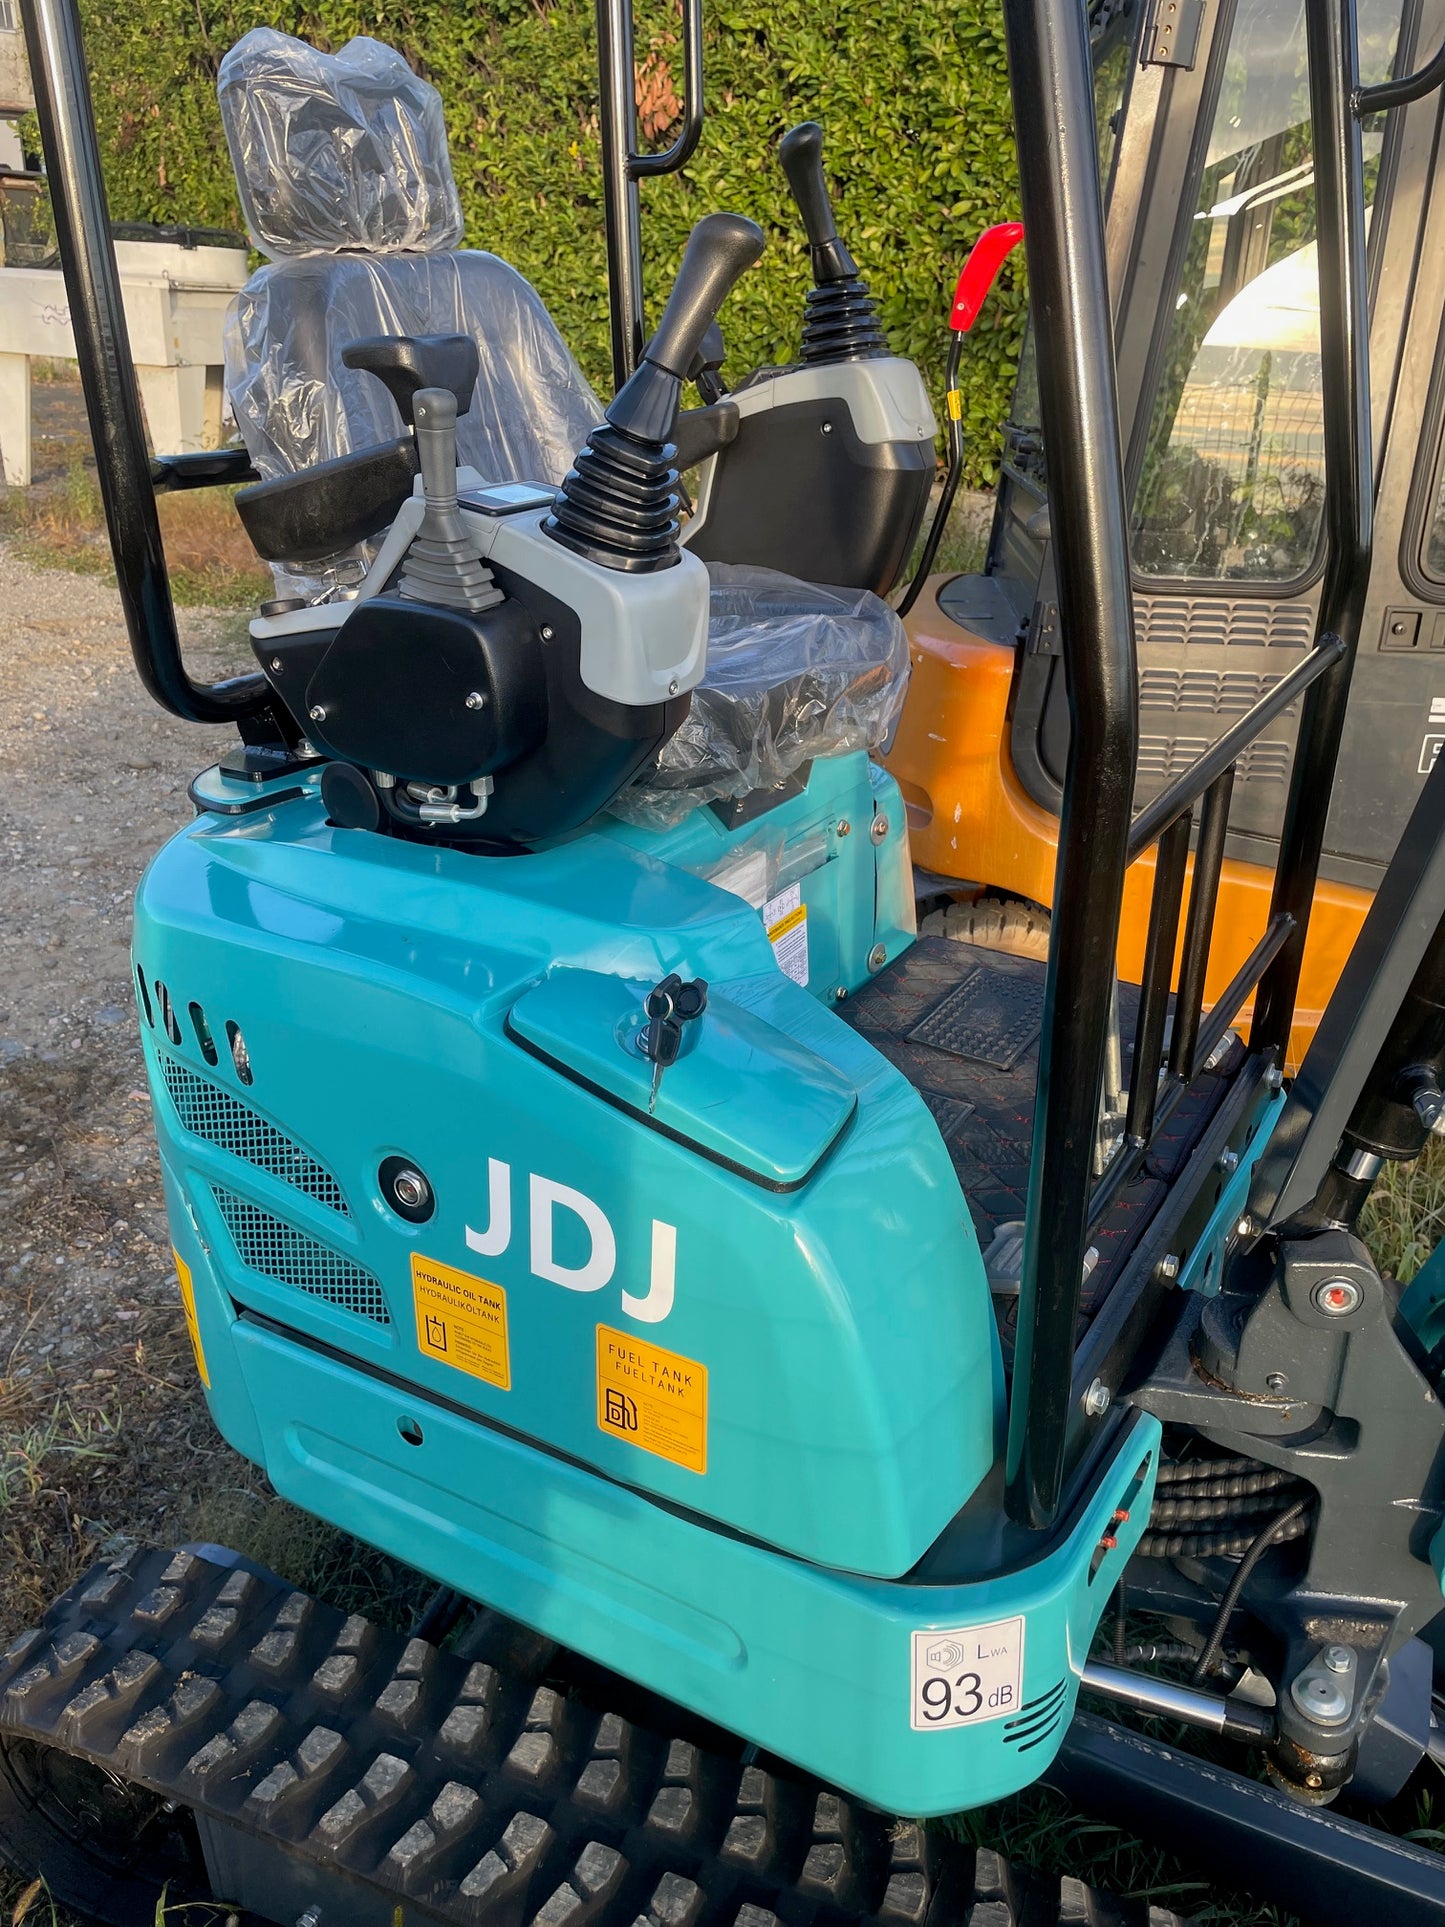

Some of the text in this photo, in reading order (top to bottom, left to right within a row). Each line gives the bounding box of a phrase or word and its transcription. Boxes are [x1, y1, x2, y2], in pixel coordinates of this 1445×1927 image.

[465, 1157, 677, 1323] JDJ
[416, 1270, 502, 1311] HYDRAULIC OIL TANK
[608, 1343, 693, 1388] FUEL TANK
[615, 1361, 685, 1398] FUELTANK
[921, 1672, 1013, 1721] 93 dB
